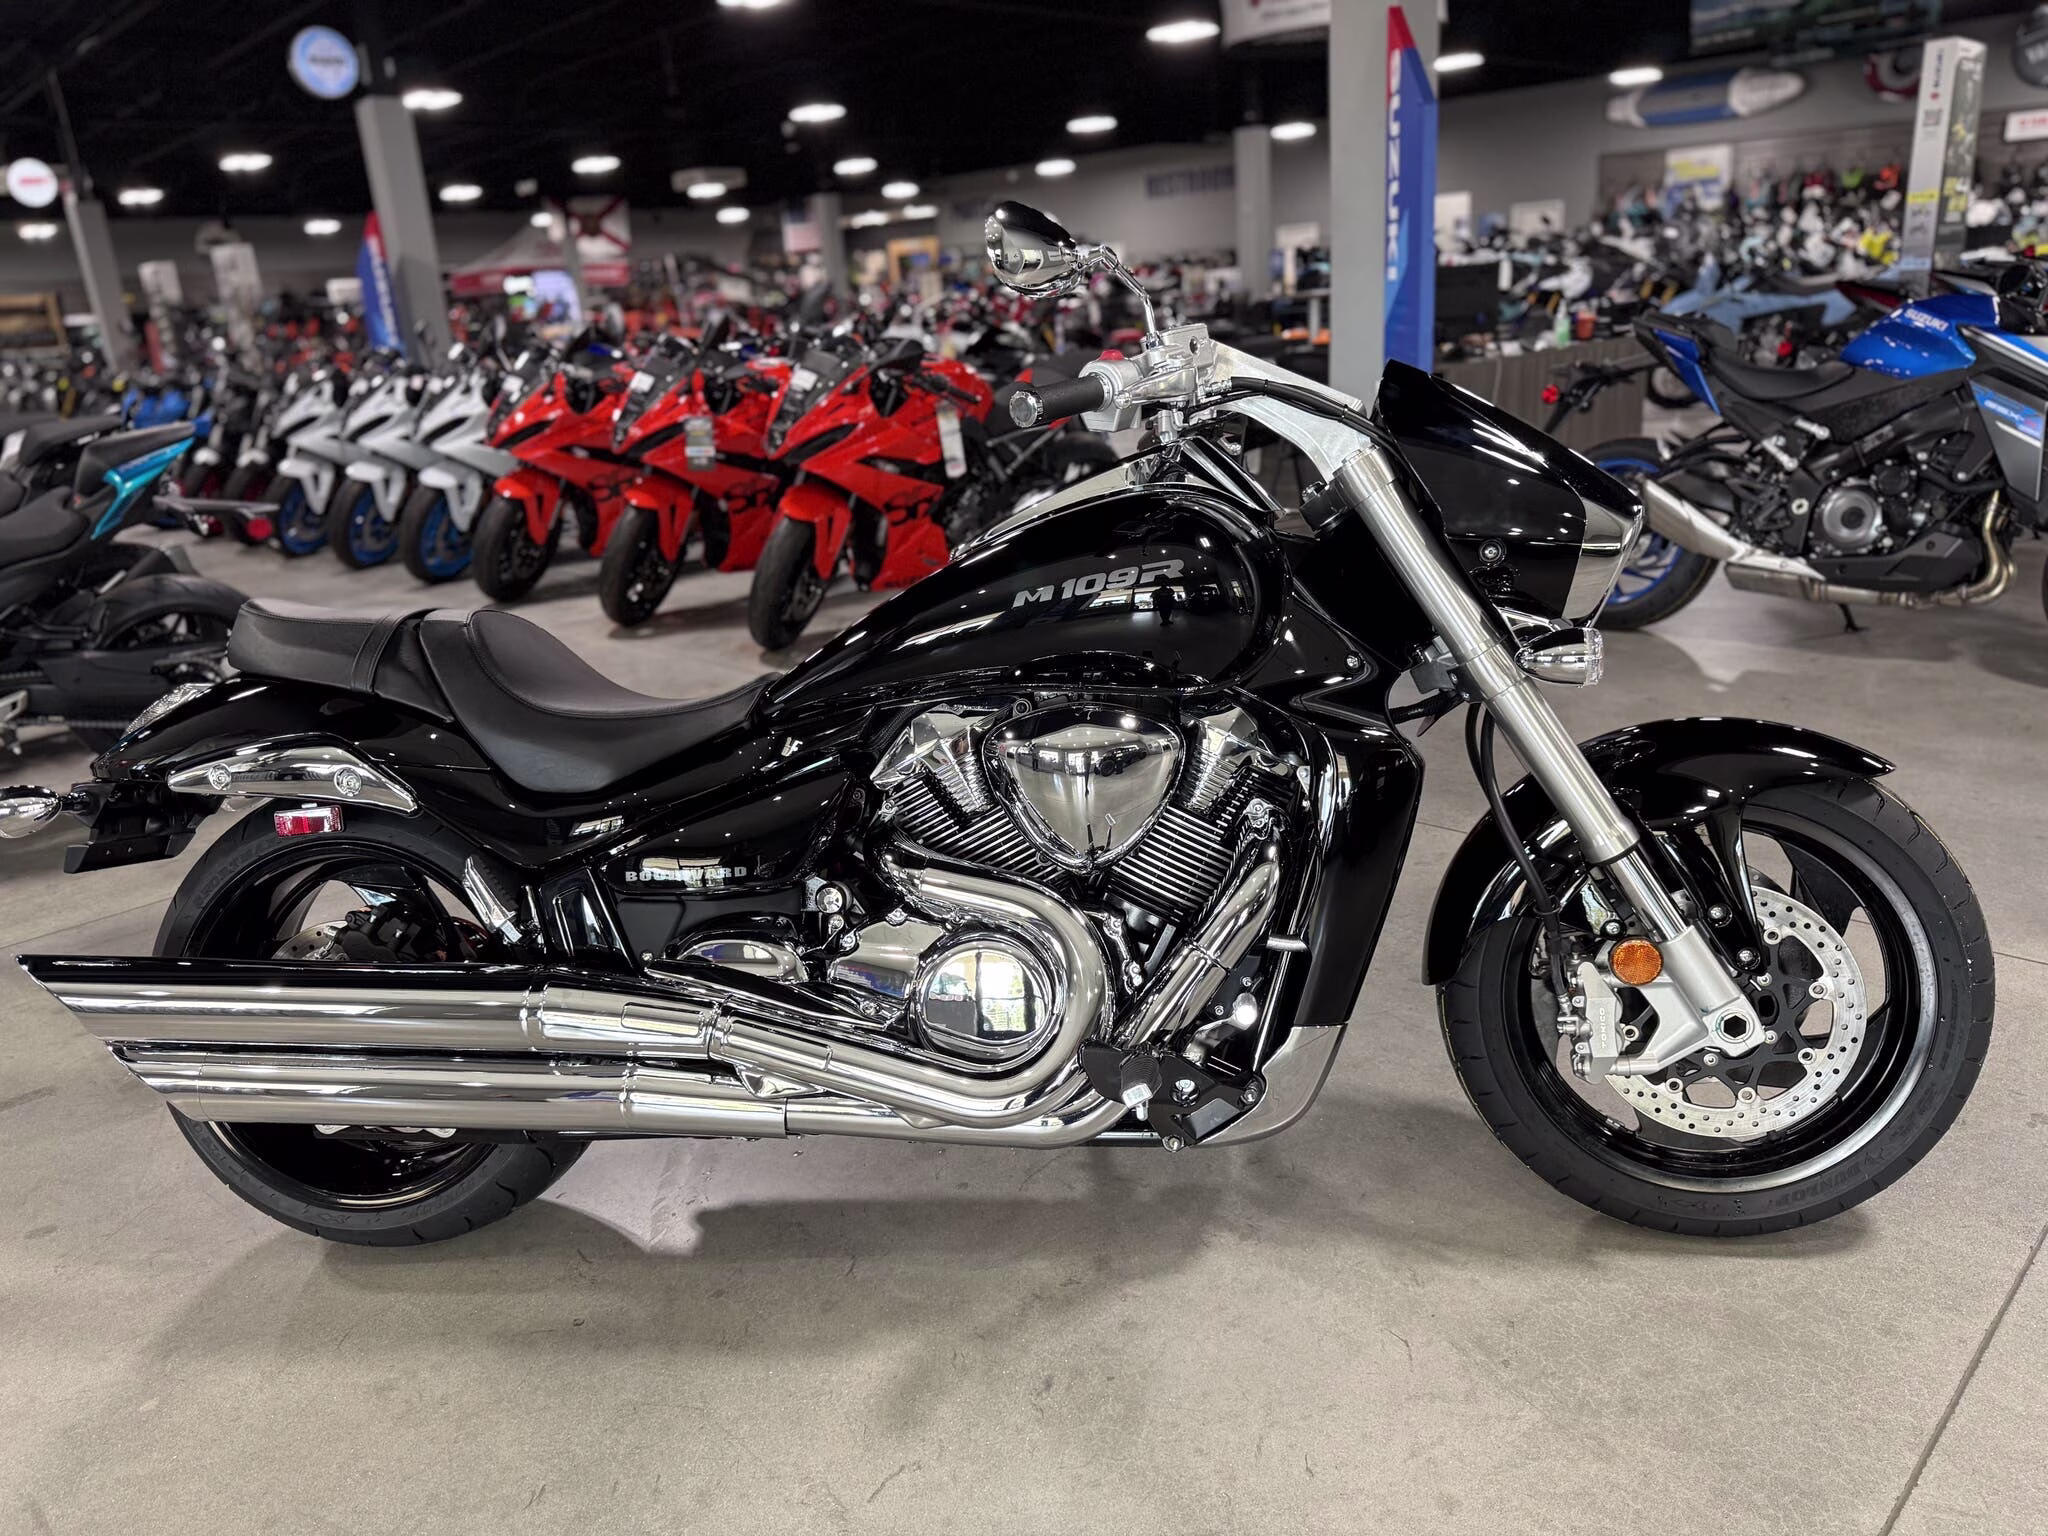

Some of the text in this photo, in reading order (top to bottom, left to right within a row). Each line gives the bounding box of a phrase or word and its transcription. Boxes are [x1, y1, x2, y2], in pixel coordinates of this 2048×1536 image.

[1386, 47, 1402, 281] SUZUKI
[1904, 308, 1949, 332] SUZUKI
[1599, 1007, 1607, 1049] TOKICO
